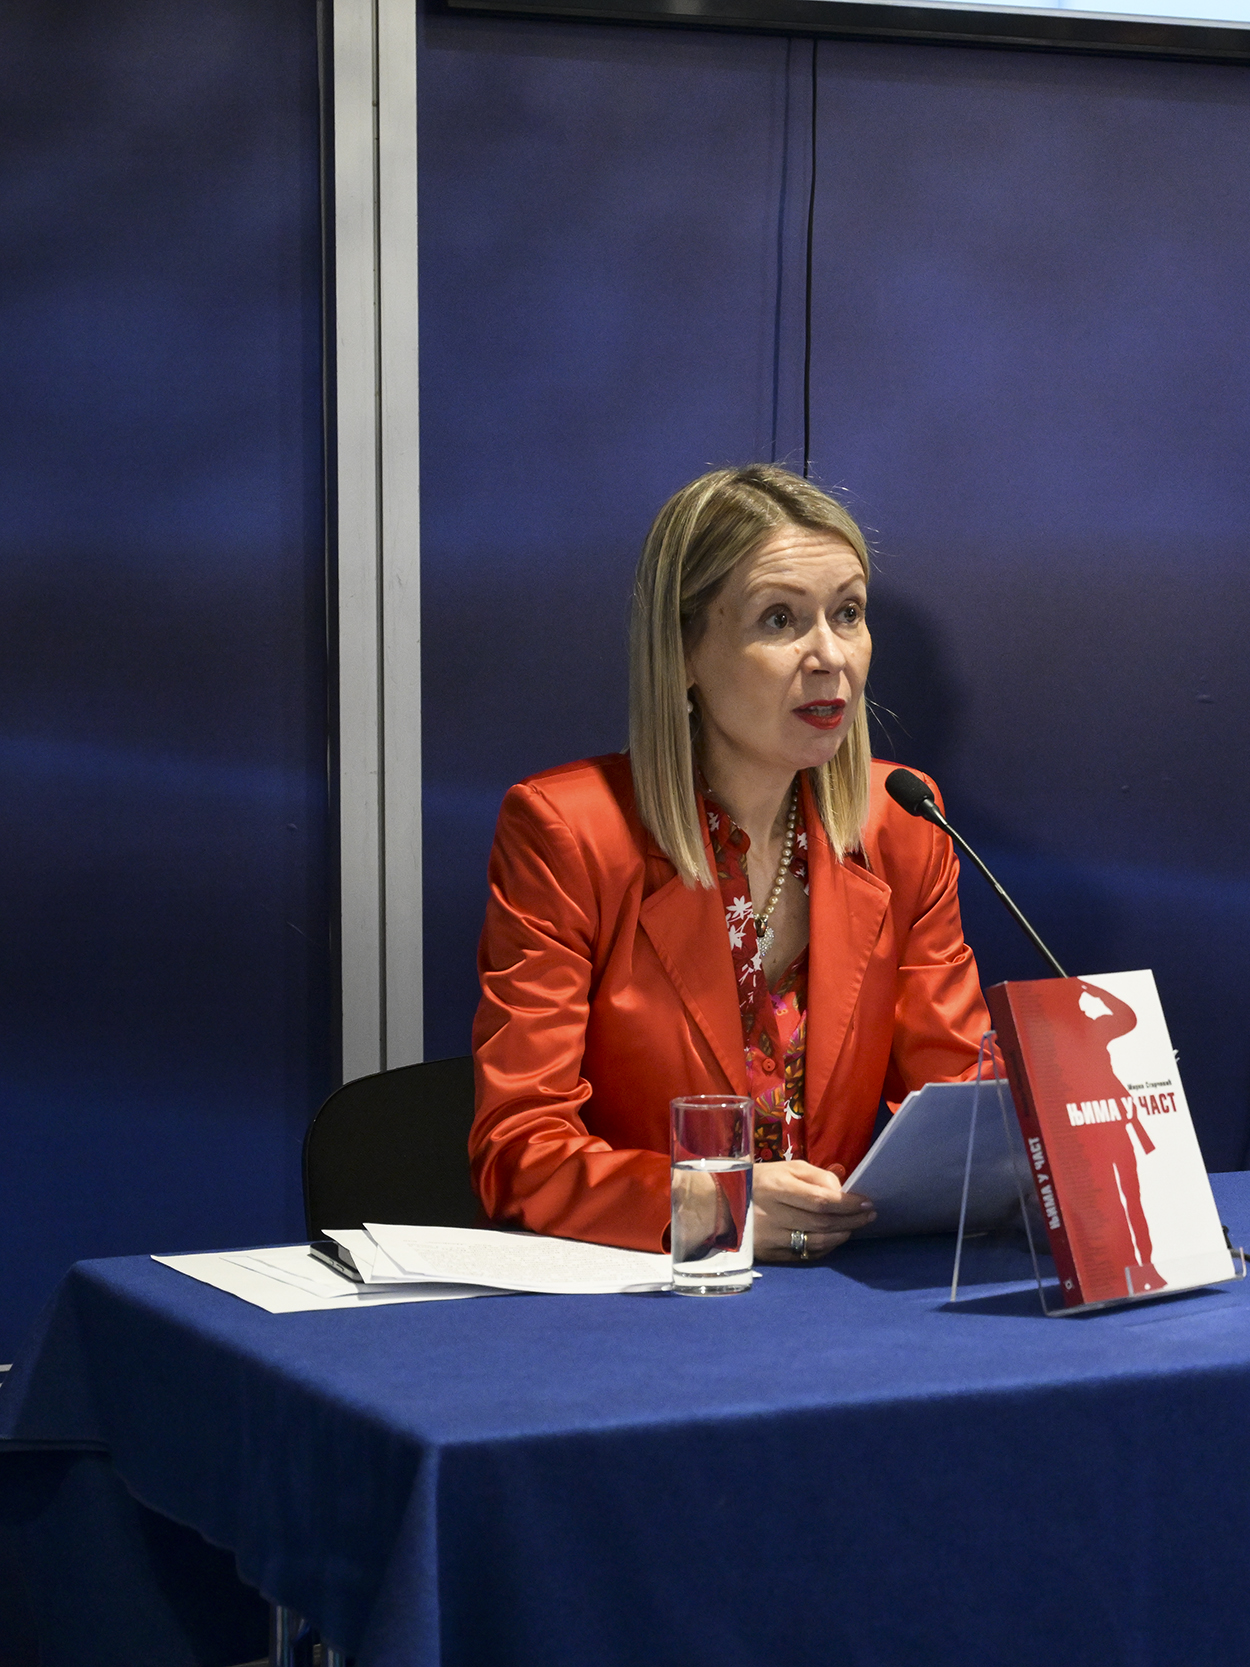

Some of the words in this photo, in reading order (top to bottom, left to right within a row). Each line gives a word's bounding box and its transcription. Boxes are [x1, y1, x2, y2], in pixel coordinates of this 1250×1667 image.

[1066, 1098, 1122, 1126] ЊИМА
[1121, 1096, 1134, 1120] У
[1138, 1092, 1177, 1116] ЧАСТ
